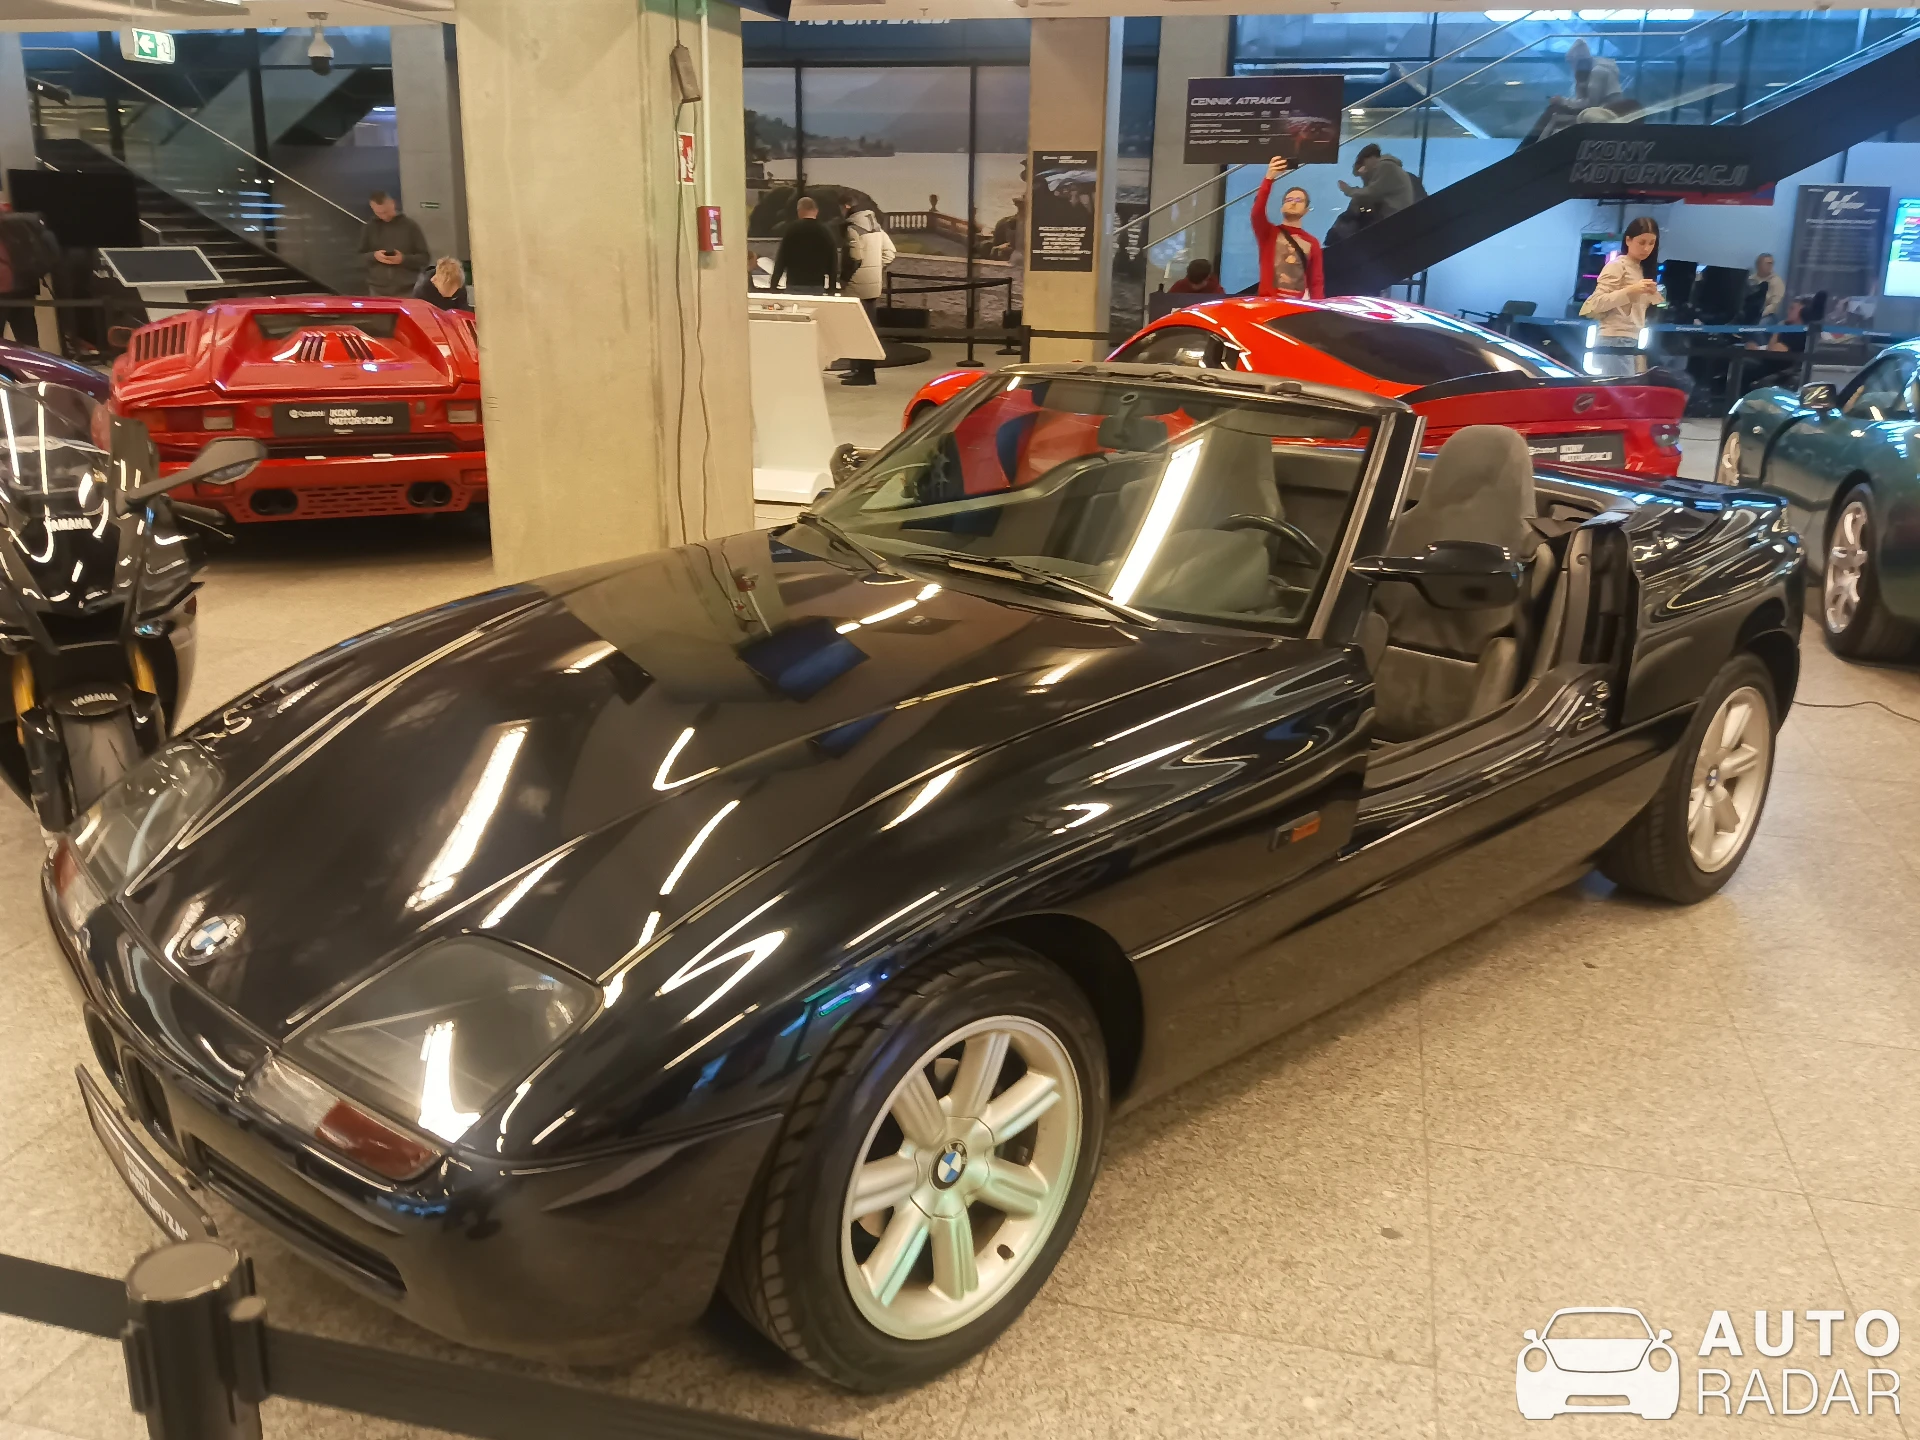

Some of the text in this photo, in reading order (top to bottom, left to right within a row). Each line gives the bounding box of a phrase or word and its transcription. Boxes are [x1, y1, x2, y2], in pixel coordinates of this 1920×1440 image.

[1190, 95, 1291, 106] CENNIK ATRAKCJI
[1576, 140, 1655, 161] IKONY
[1569, 162, 1750, 186] MOTORYZACJI
[71, 693, 118, 707] YAMAHA
